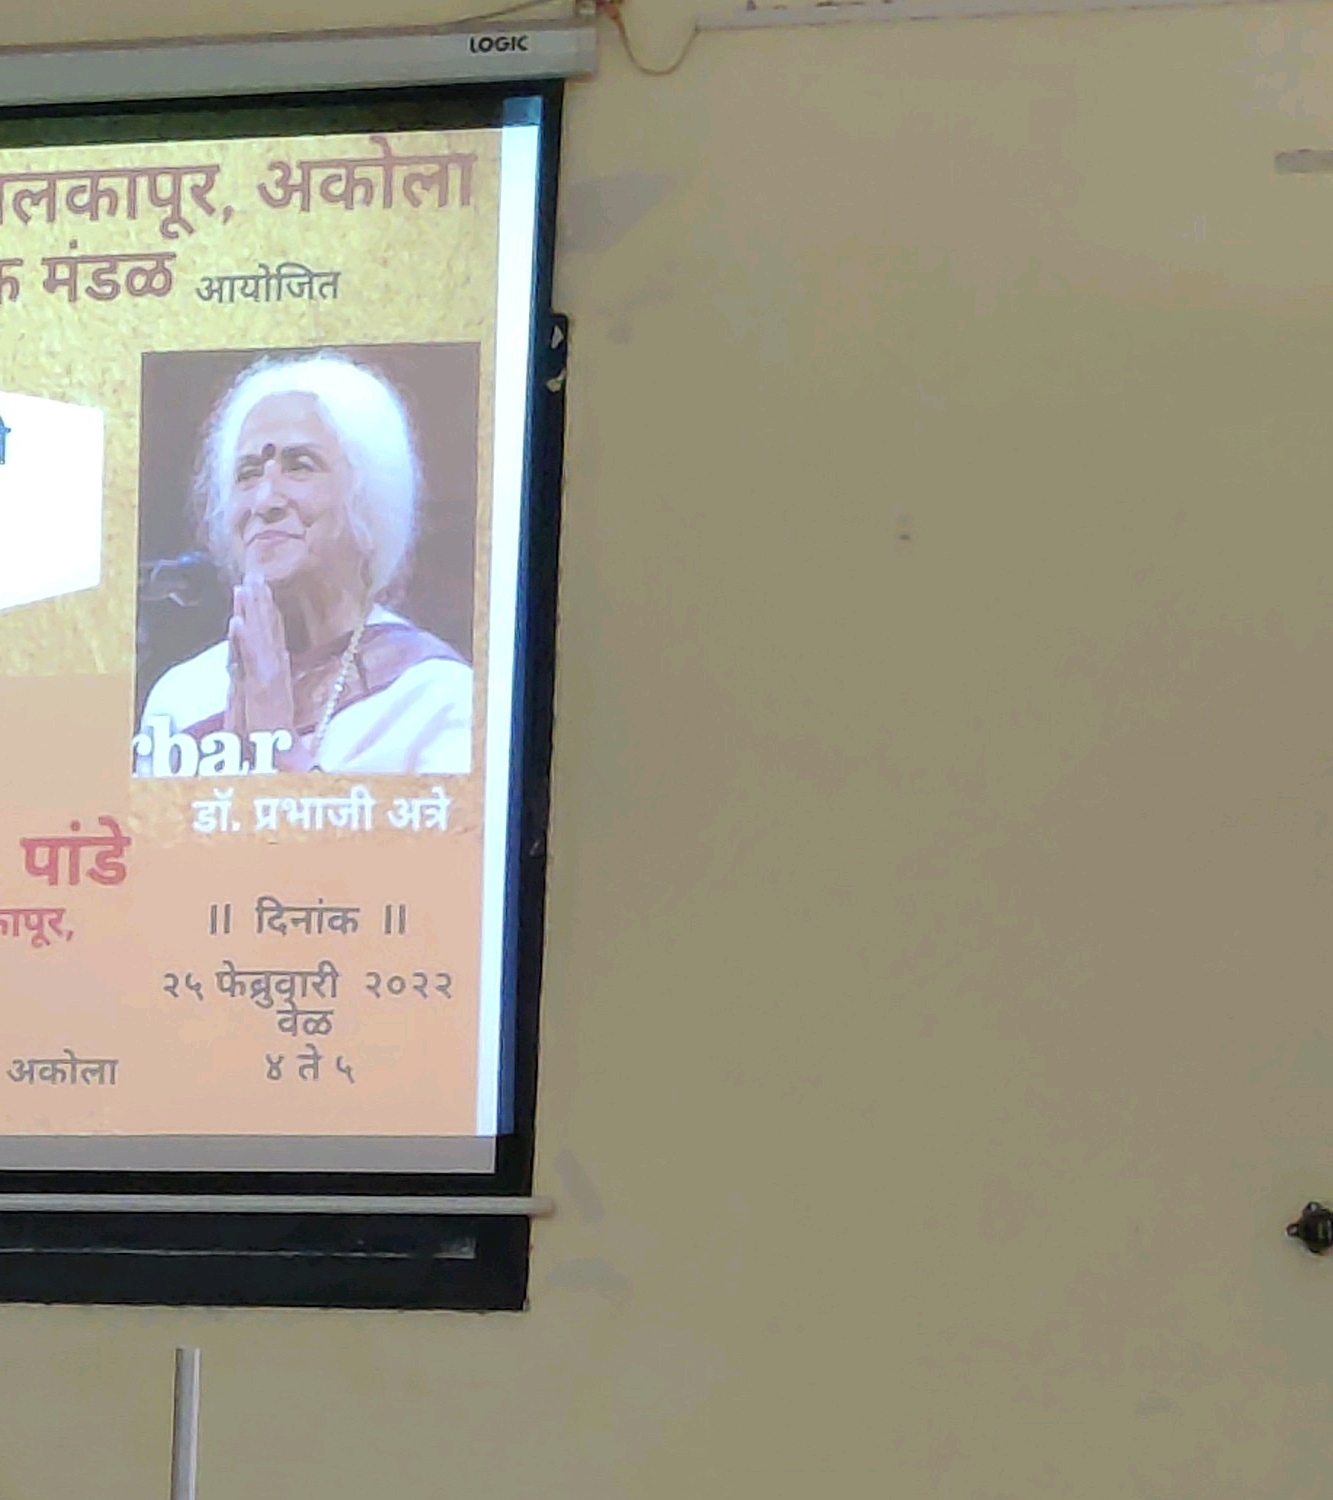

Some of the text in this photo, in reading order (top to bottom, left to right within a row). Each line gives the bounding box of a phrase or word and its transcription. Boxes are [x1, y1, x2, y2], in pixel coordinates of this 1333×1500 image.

[469, 36, 529, 53] LOGIC
[257, 136, 477, 213] अकोला
[43, 240, 176, 305] मंडळ
[196, 263, 342, 305] आयोजित
[192, 784, 452, 833] डॉ. प्रभाजी अत्रे
[19, 816, 133, 887] पांडे
[255, 896, 360, 935] दिनांक
[163, 960, 453, 1009] २५ फेब्रुवारी २०२२
[276, 999, 334, 1036] वेळ
[5, 1048, 119, 1086] अकोला
[265, 1043, 355, 1083] ४ ते ५
